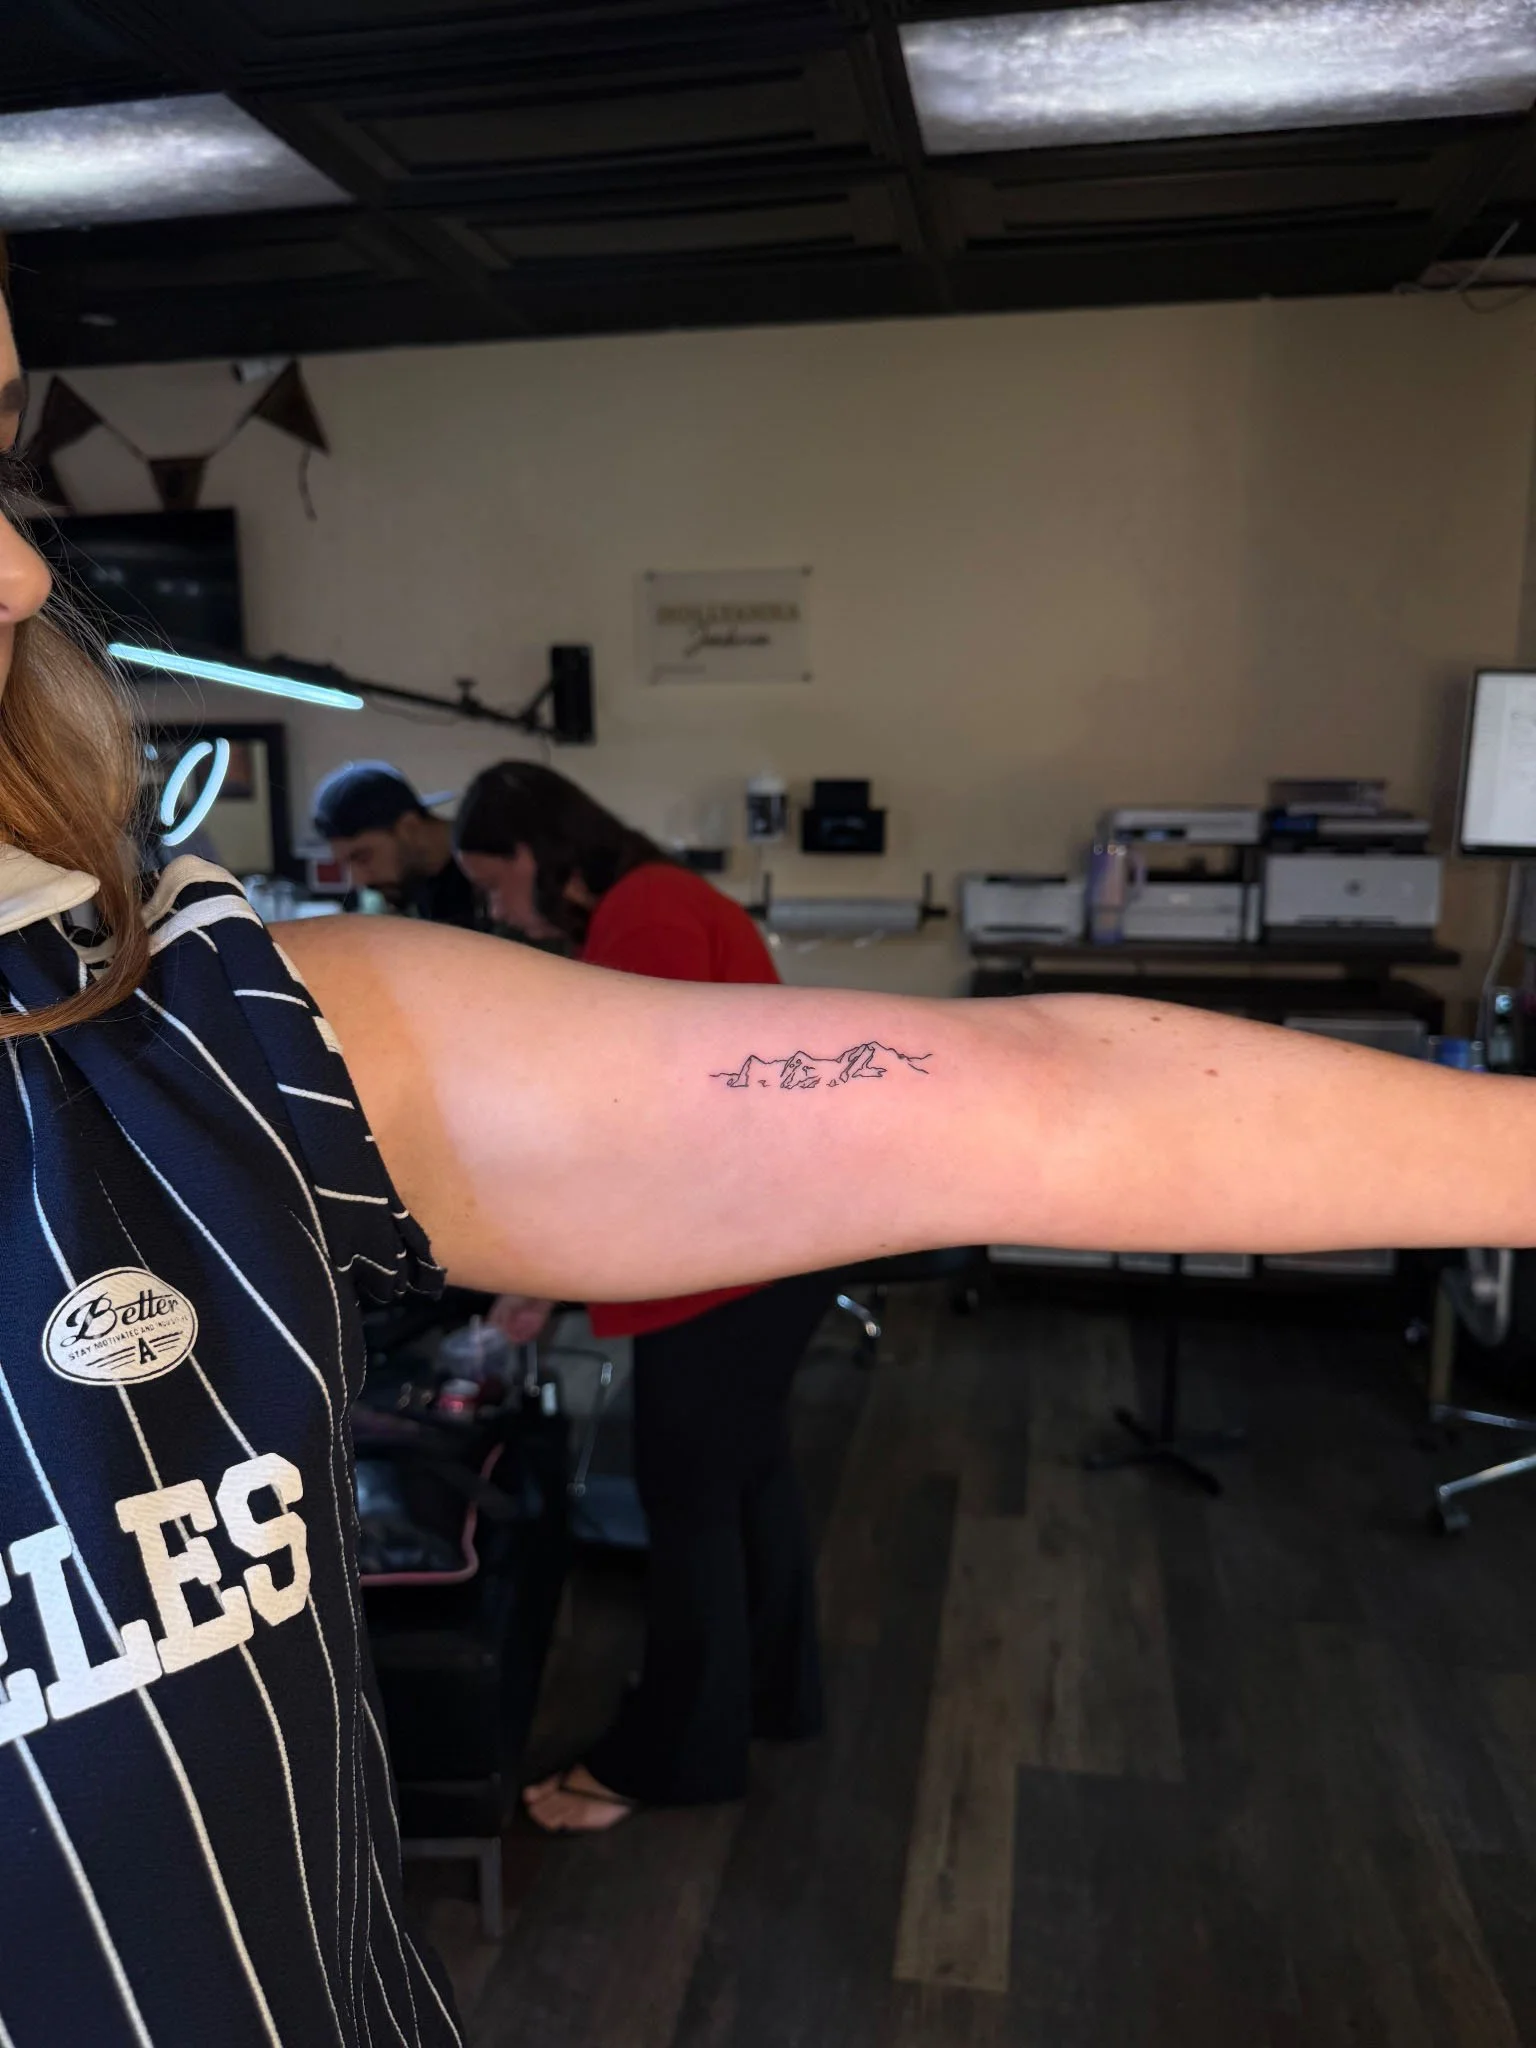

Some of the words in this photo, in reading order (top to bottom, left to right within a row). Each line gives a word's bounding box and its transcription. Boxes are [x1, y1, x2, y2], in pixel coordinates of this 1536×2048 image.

[60, 1289, 179, 1347] Better
[69, 1346, 91, 1360] STAY
[138, 1338, 158, 1365] A
